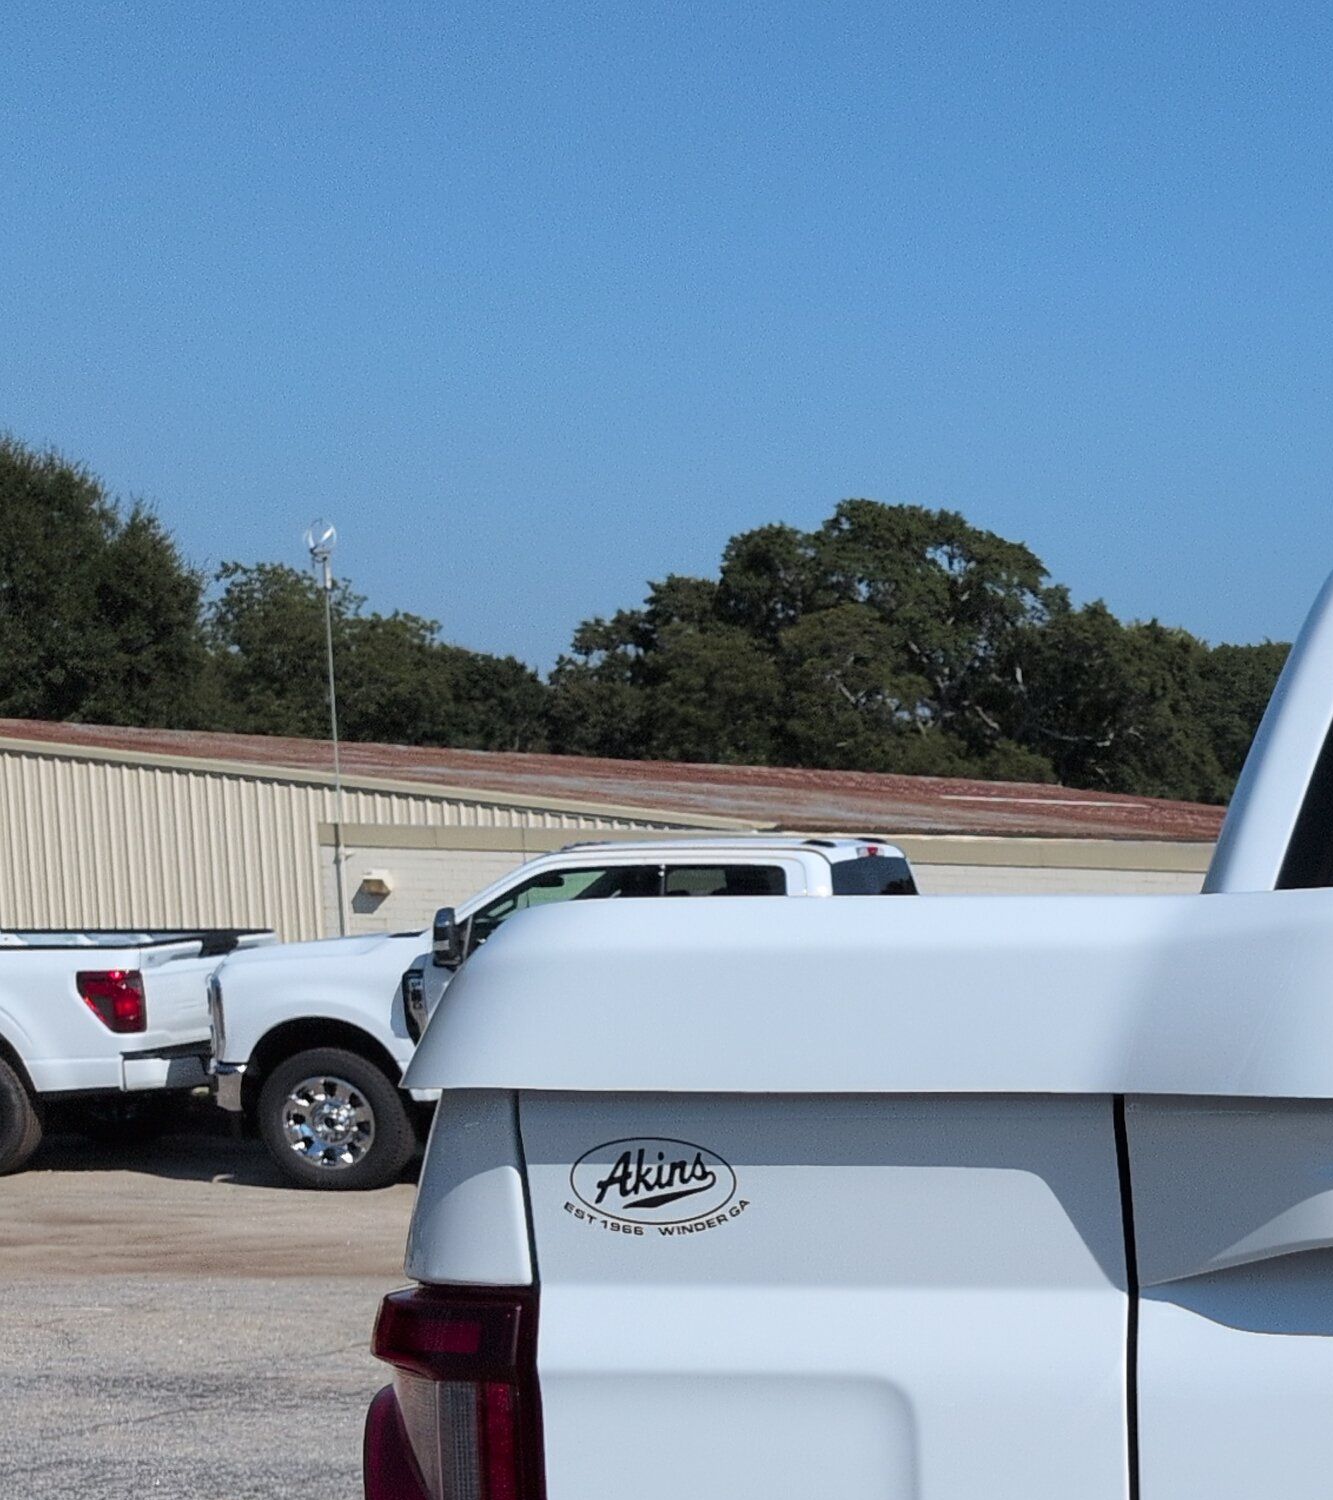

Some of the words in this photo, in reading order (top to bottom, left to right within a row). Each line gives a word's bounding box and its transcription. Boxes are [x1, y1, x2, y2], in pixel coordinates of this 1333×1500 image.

[594, 1148, 716, 1209] Akins
[563, 1201, 598, 1224] EST
[600, 1220, 645, 1236] 1966
[657, 1213, 729, 1237] WINDER
[728, 1199, 751, 1217] GA
